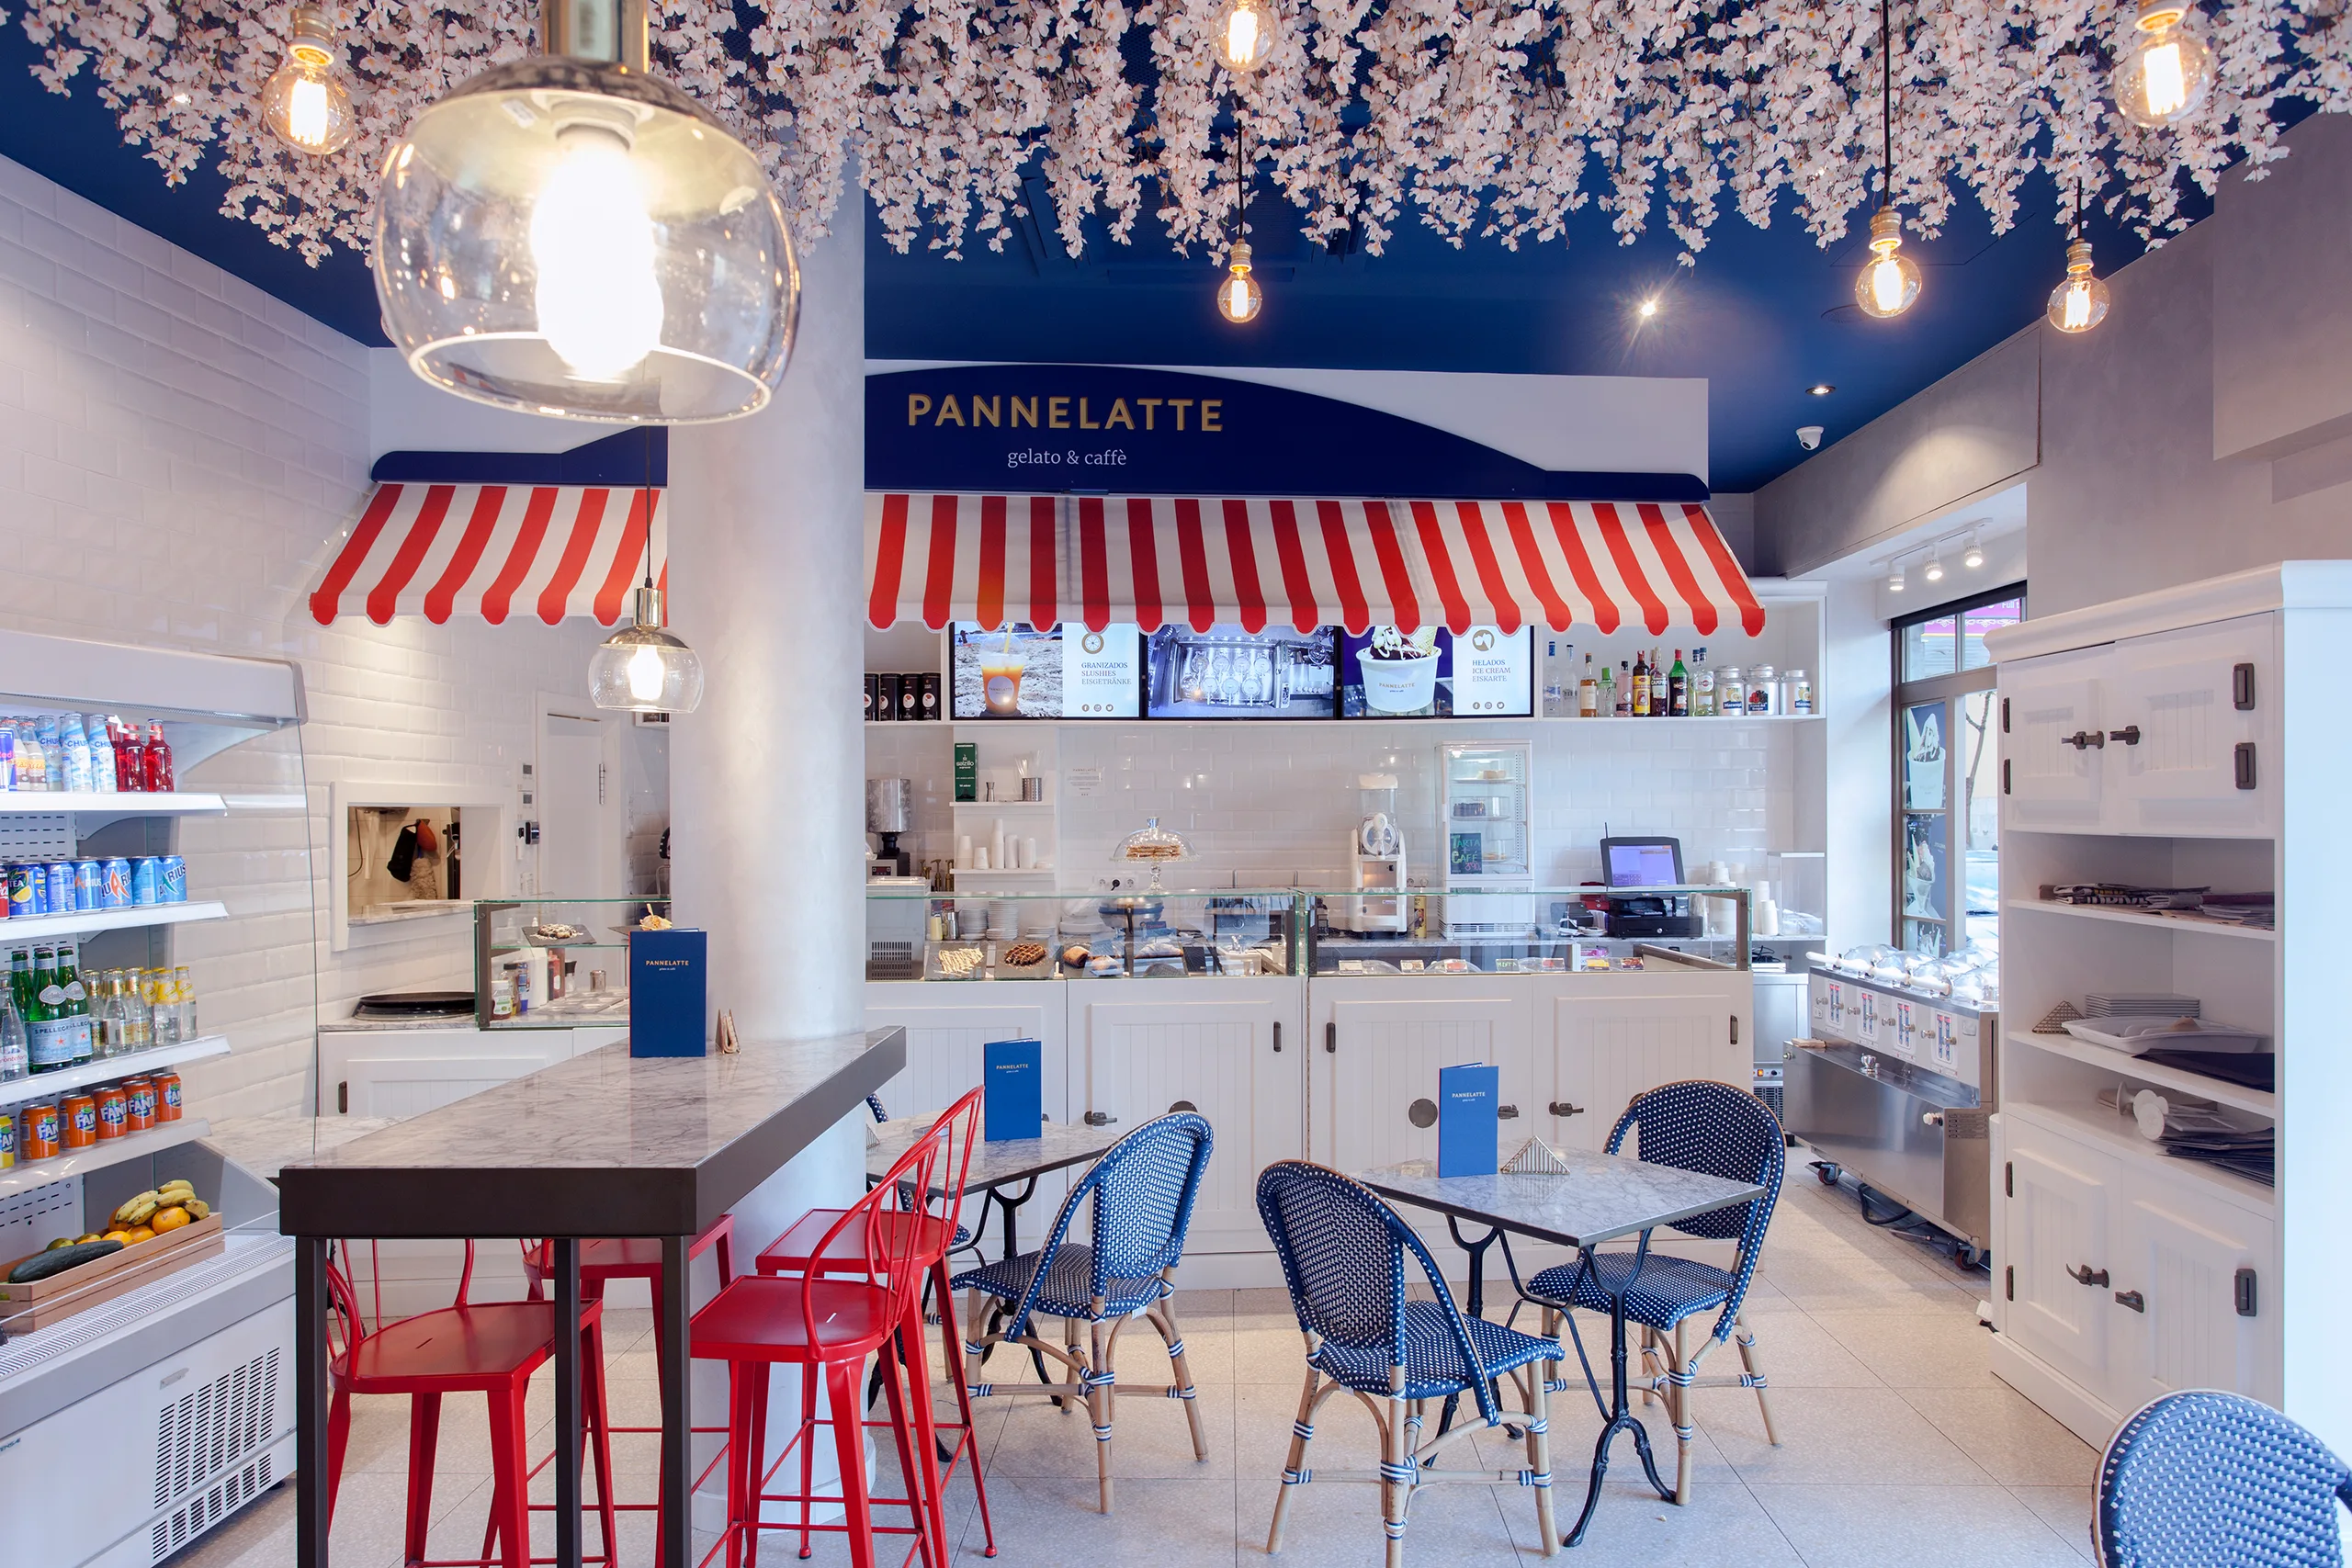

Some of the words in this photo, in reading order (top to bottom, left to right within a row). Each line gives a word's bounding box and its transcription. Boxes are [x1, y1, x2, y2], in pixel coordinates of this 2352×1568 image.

[908, 393, 1224, 432] PANNELATTE
[1007, 447, 1061, 468] gelato
[1067, 449, 1080, 465] &
[1084, 449, 1127, 466] caffè
[1081, 677, 1132, 685] EISGETRÄNKE
